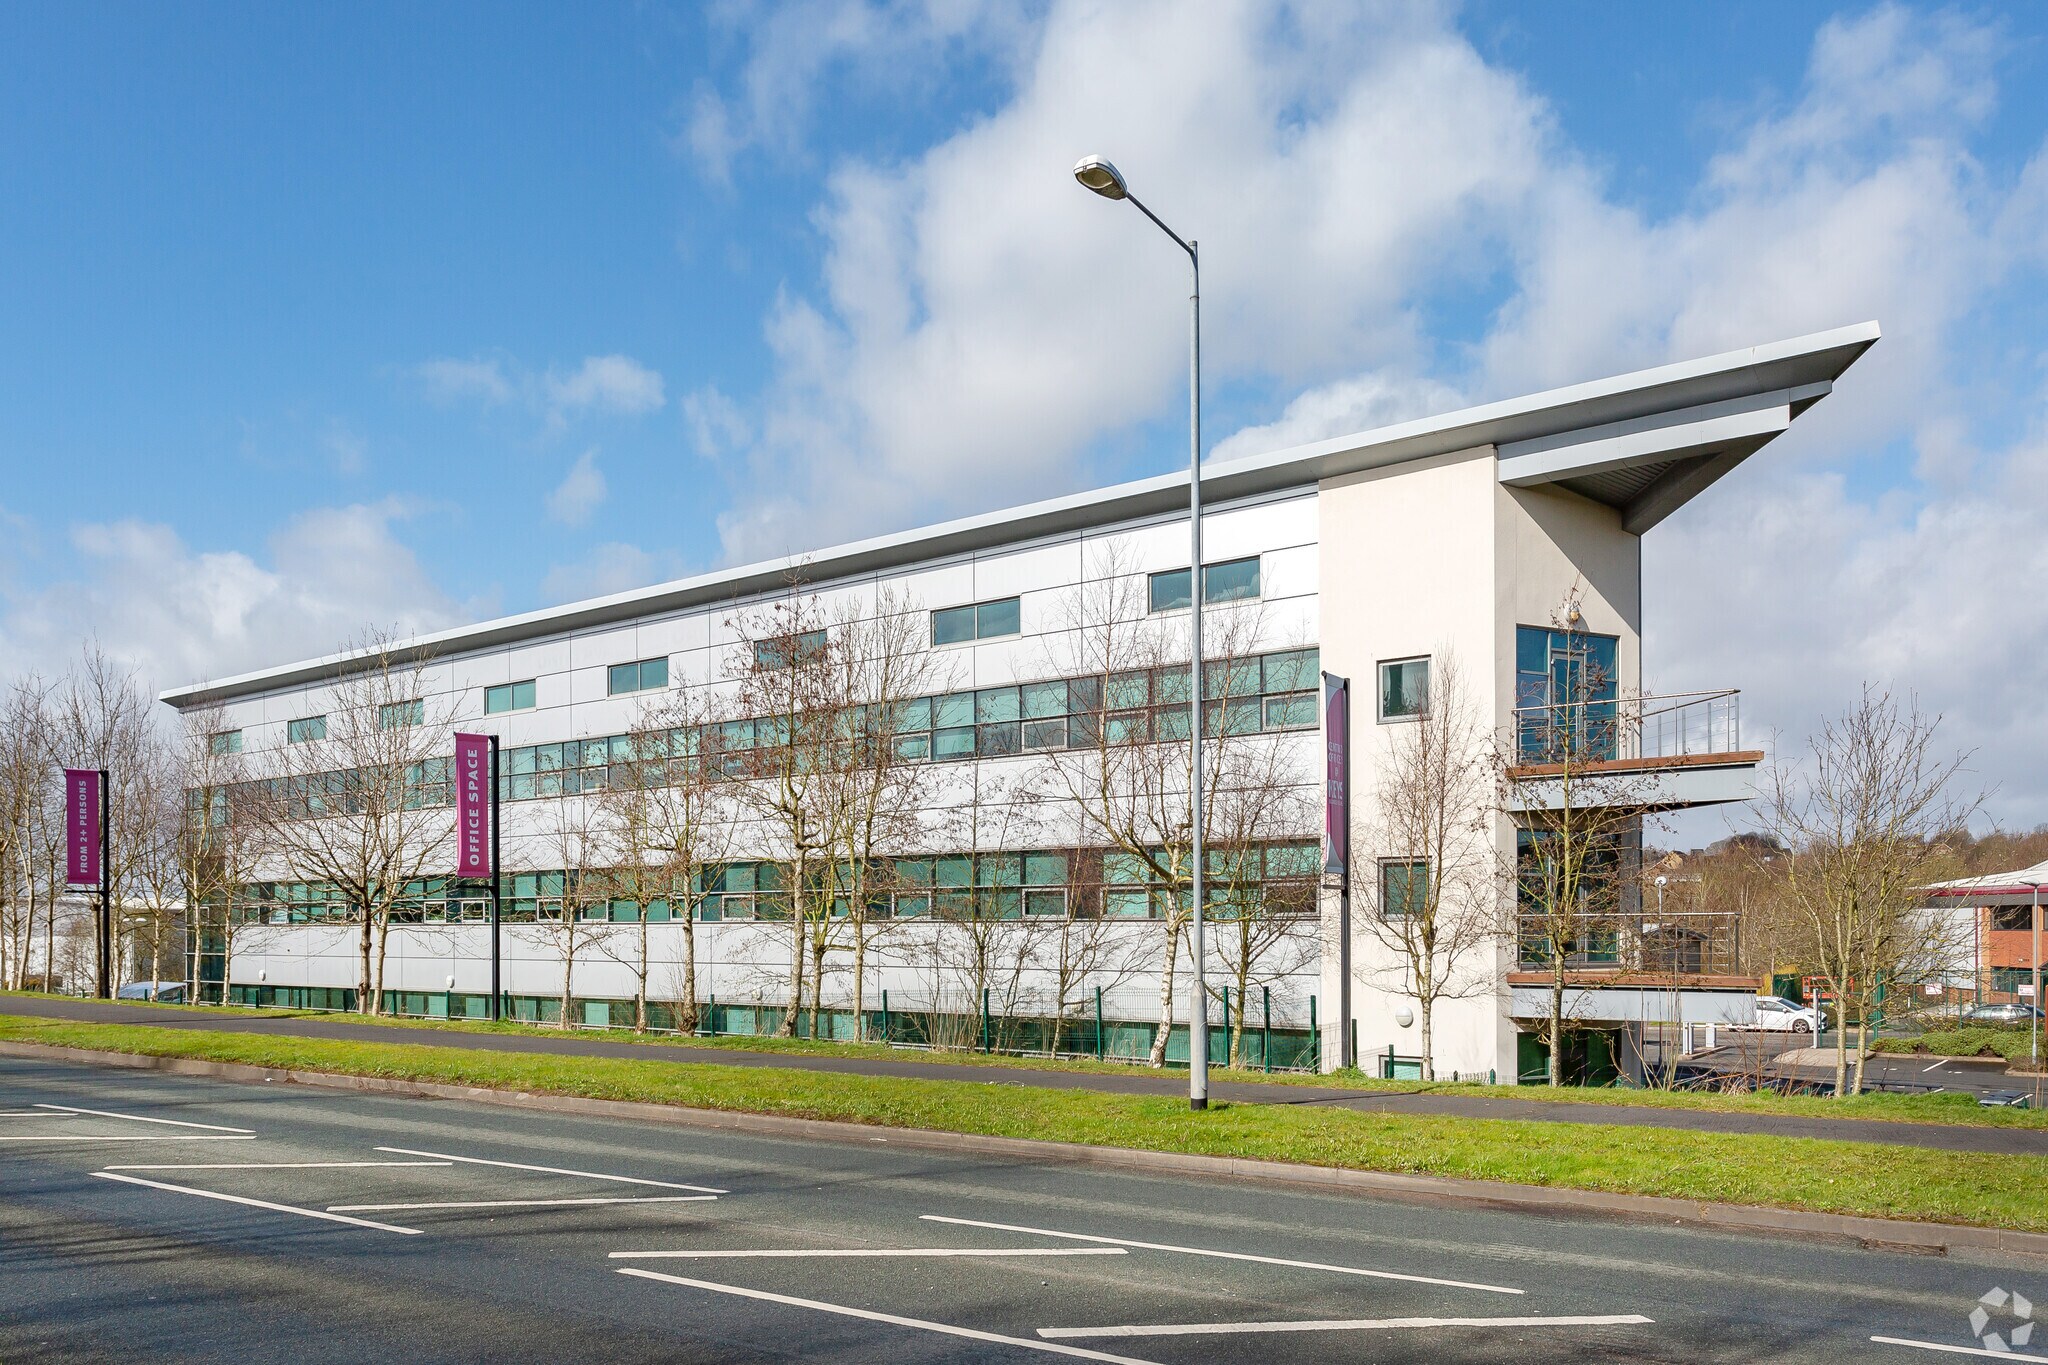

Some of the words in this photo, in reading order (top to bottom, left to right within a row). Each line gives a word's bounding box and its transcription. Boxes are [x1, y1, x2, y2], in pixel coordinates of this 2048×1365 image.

[468, 749, 479, 803] SPACE
[1328, 779, 1343, 800] KEYS
[79, 780, 87, 826] PERSONS
[80, 829, 88, 842] 2+
[469, 809, 480, 866] OFFICE
[80, 846, 88, 873] FROM
